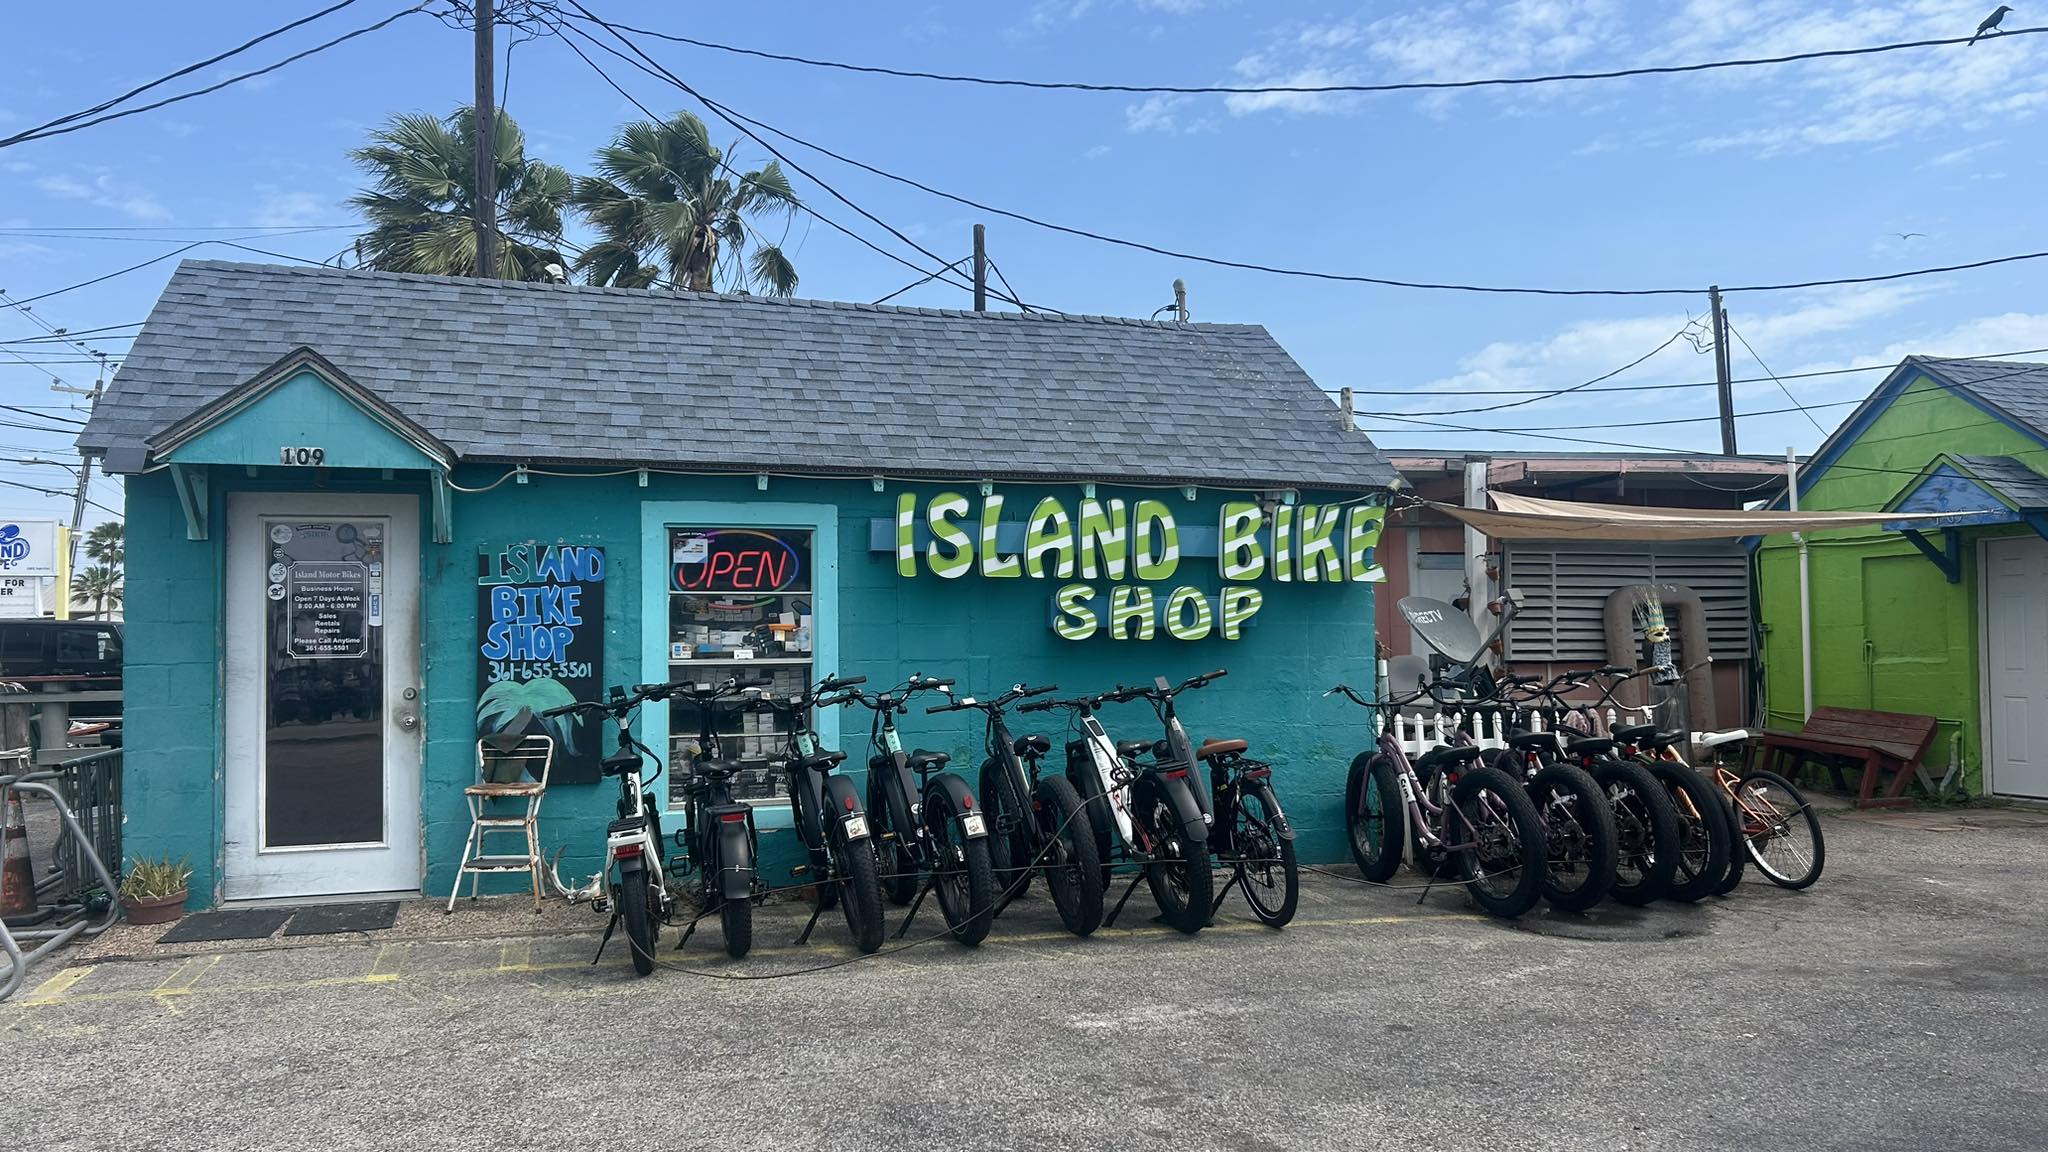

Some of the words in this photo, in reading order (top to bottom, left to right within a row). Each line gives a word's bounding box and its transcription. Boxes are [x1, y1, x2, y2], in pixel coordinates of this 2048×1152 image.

[284, 448, 324, 465] 109
[895, 491, 1180, 581] ISLAND
[1218, 501, 1388, 583] BIKE
[294, 570, 317, 579] Island
[319, 570, 340, 579] Motor
[342, 570, 361, 579] Bikes
[478, 544, 605, 585] ISLAND
[679, 551, 787, 588] OPEN
[294, 595, 312, 603] Open
[319, 595, 335, 603] Days
[491, 584, 582, 626] BIKE
[1053, 582, 1263, 641] SHOP
[332, 637, 361, 645] Anytime
[480, 621, 574, 663] SHOP
[487, 660, 592, 683] 361-655-5501
